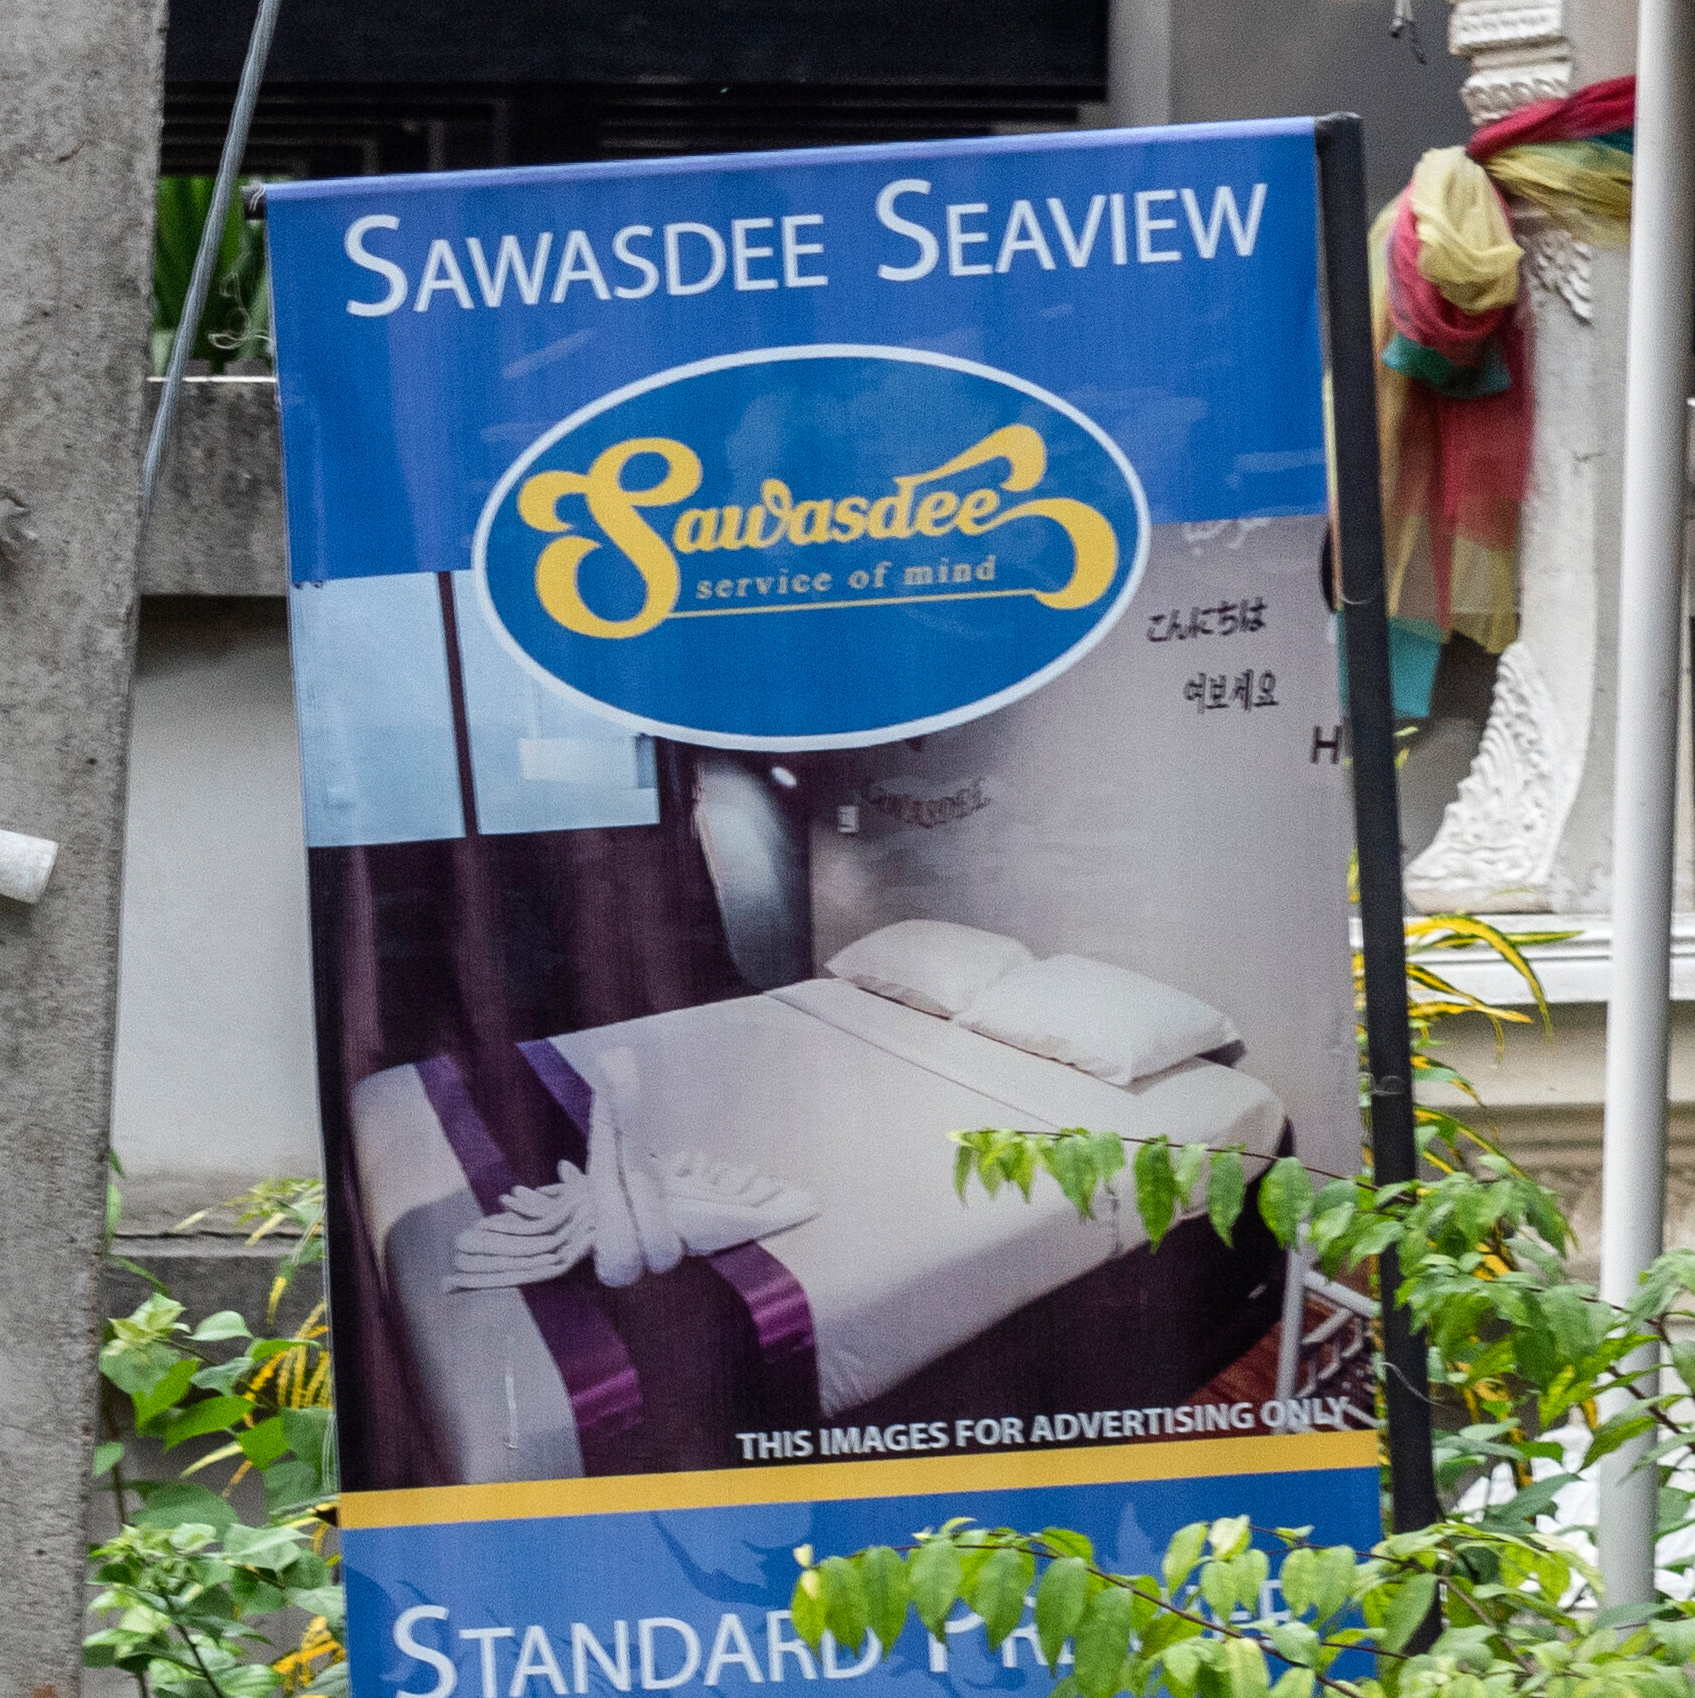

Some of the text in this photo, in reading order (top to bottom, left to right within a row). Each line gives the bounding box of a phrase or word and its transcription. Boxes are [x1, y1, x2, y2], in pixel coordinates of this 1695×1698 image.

[517, 424, 1118, 639] Sawasdee
[695, 553, 998, 600] service of mind
[1146, 597, 1268, 643] こんにちは
[735, 1395, 1351, 1460] THIS IMAGES FOR ADVERTISING ONLY
